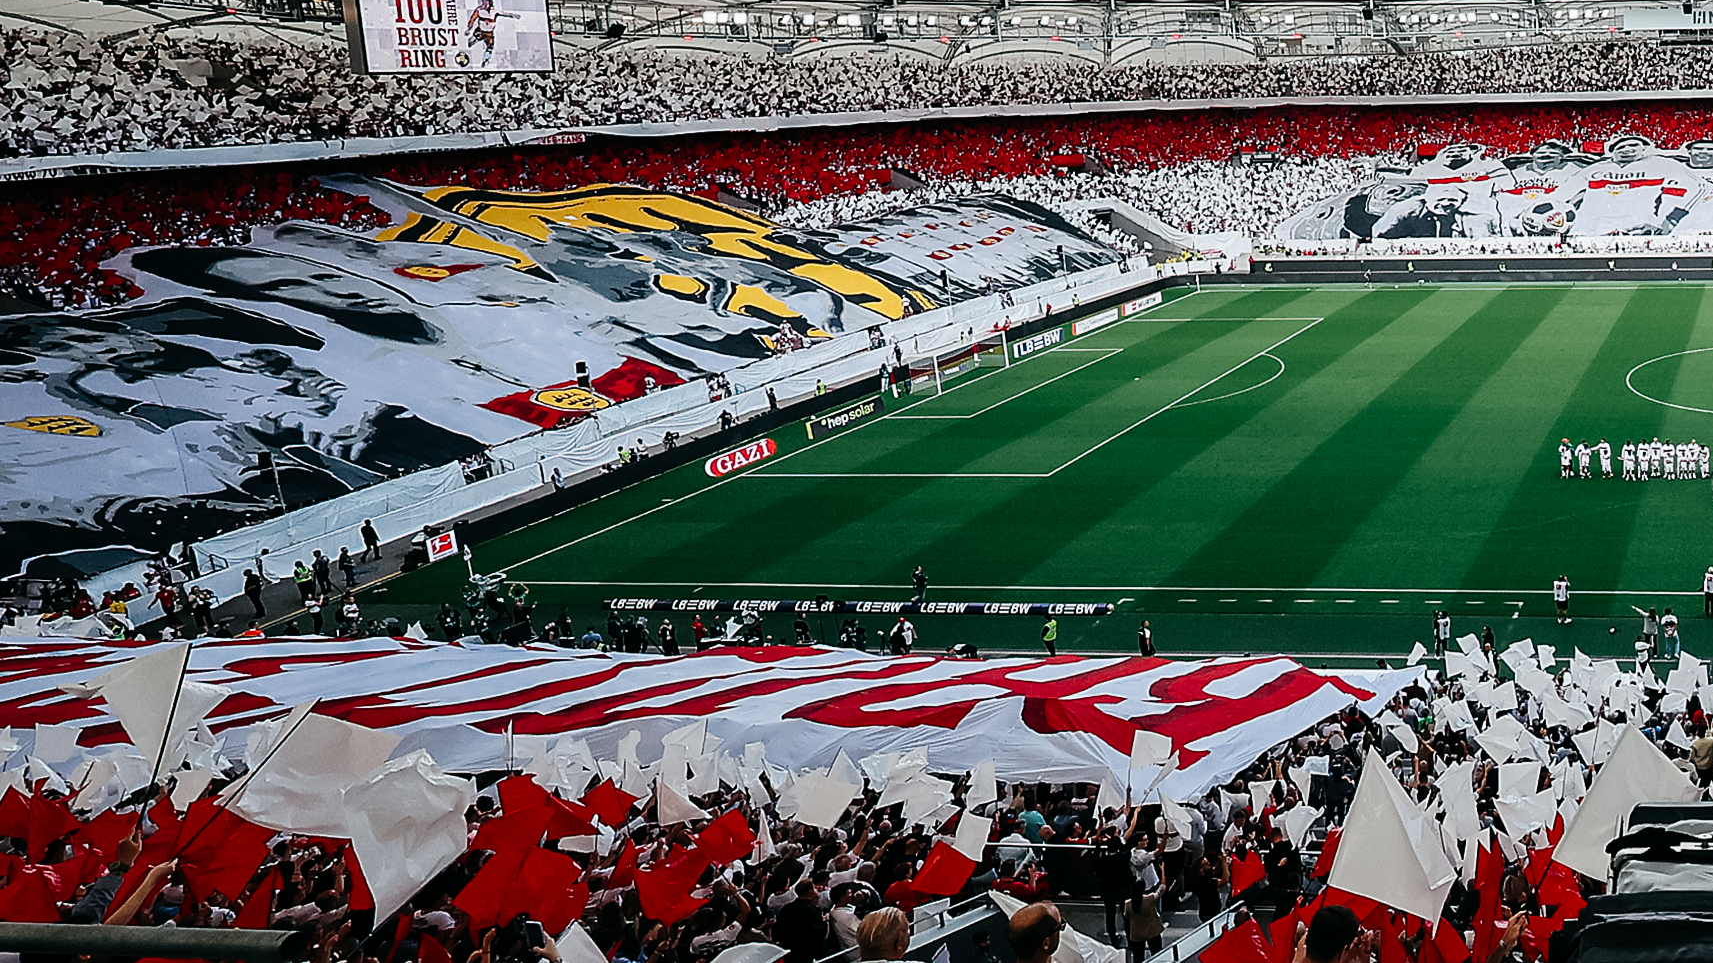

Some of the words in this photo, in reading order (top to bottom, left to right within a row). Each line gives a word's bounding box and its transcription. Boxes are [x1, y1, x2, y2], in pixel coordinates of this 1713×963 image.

[396, 27, 459, 47] BRUST
[400, 50, 446, 68] RING
[1591, 171, 1646, 180] Canon
